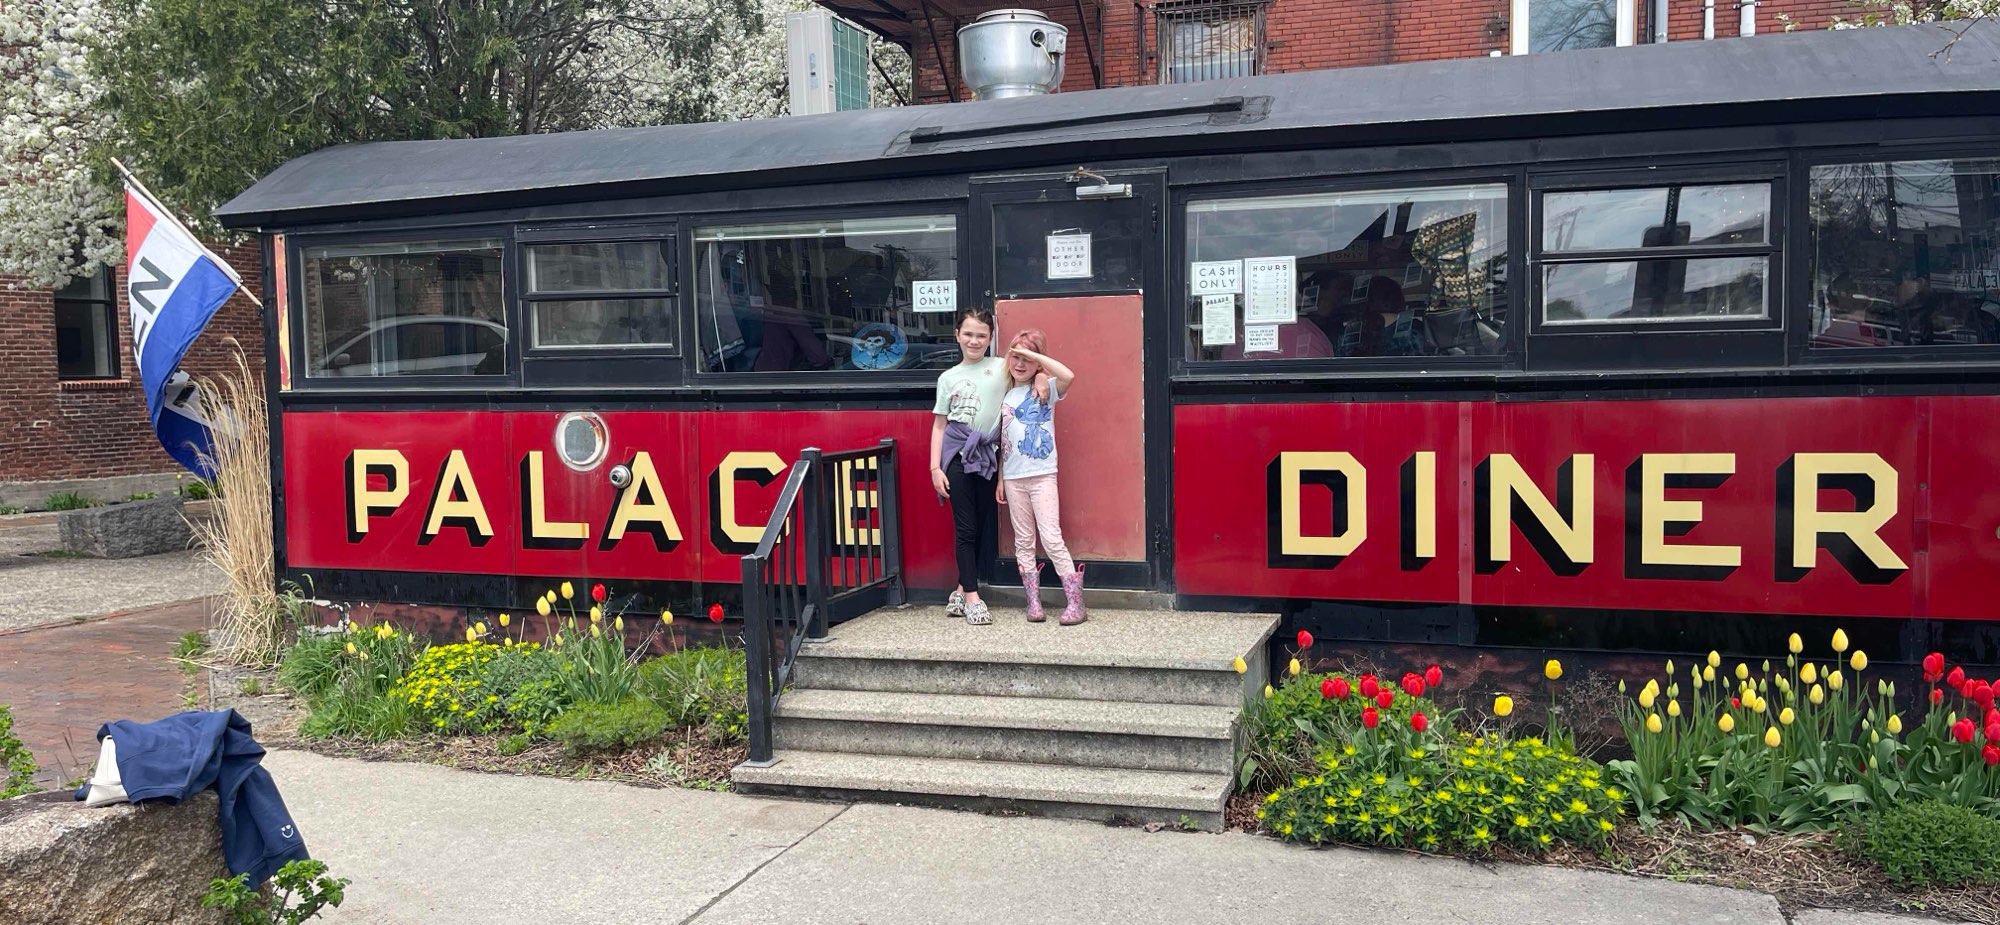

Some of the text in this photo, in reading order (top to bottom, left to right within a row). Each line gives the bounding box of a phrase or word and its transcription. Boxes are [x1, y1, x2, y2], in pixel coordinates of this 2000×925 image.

[1054, 245, 1084, 253] OTHER
[1199, 266, 1236, 277] CA$H
[1252, 264, 1288, 272] HOURS
[1199, 279, 1236, 289] ONLY
[919, 285, 950, 295] CA$H
[920, 297, 951, 305] ONLY
[345, 449, 1910, 585] PALACE DINER
